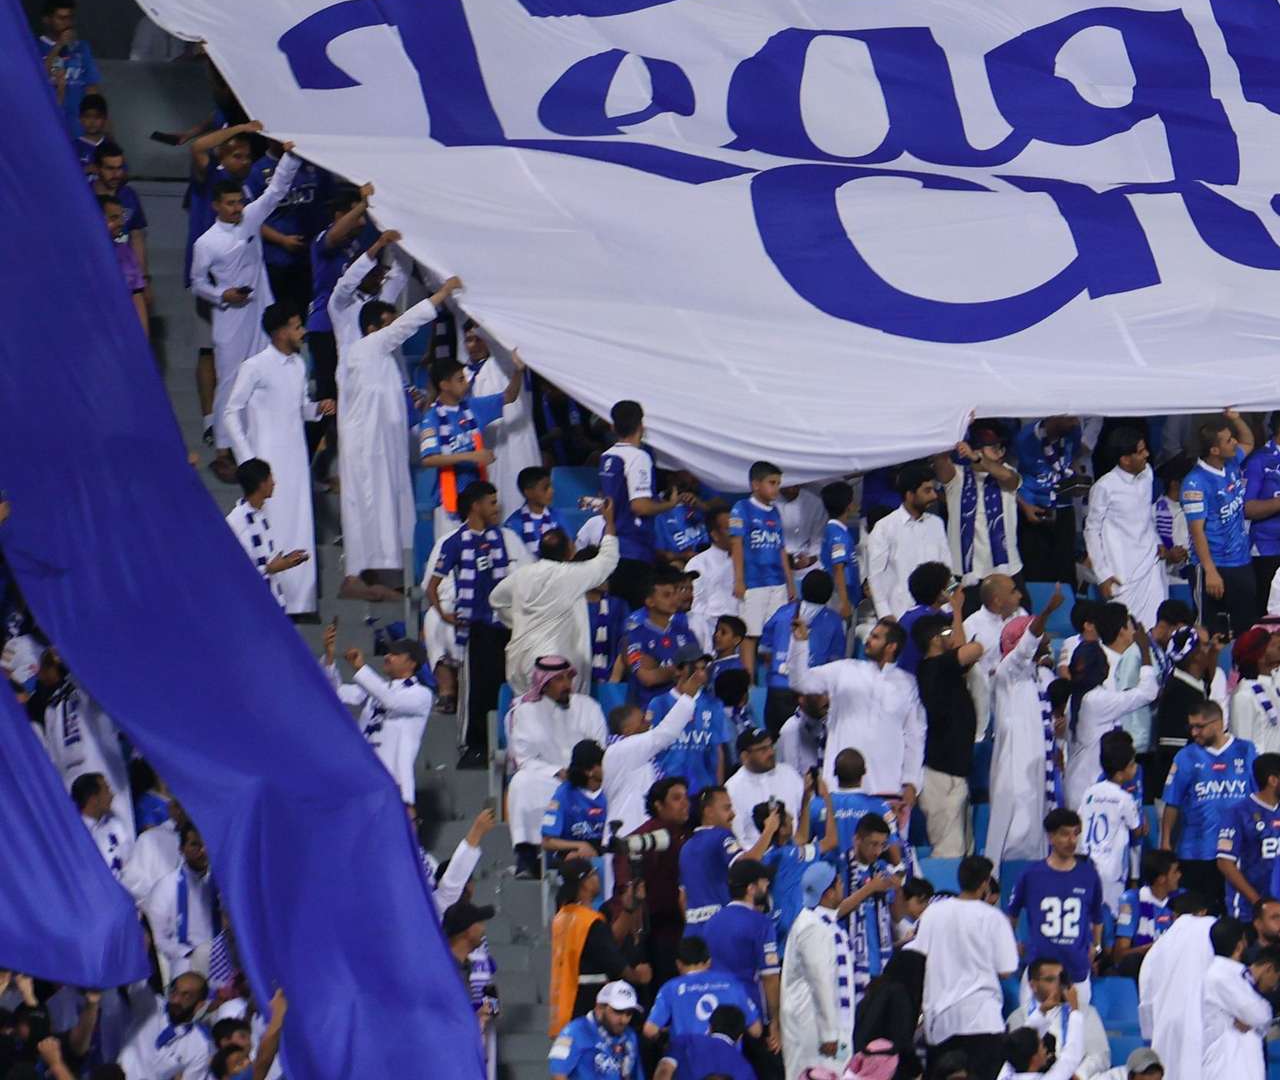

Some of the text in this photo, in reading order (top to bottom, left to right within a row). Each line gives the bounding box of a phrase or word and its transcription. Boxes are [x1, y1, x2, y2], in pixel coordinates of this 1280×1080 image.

[1195, 780, 1246, 796] SAVVY
[1086, 812, 1109, 845] 10
[1040, 897, 1081, 938] 32
